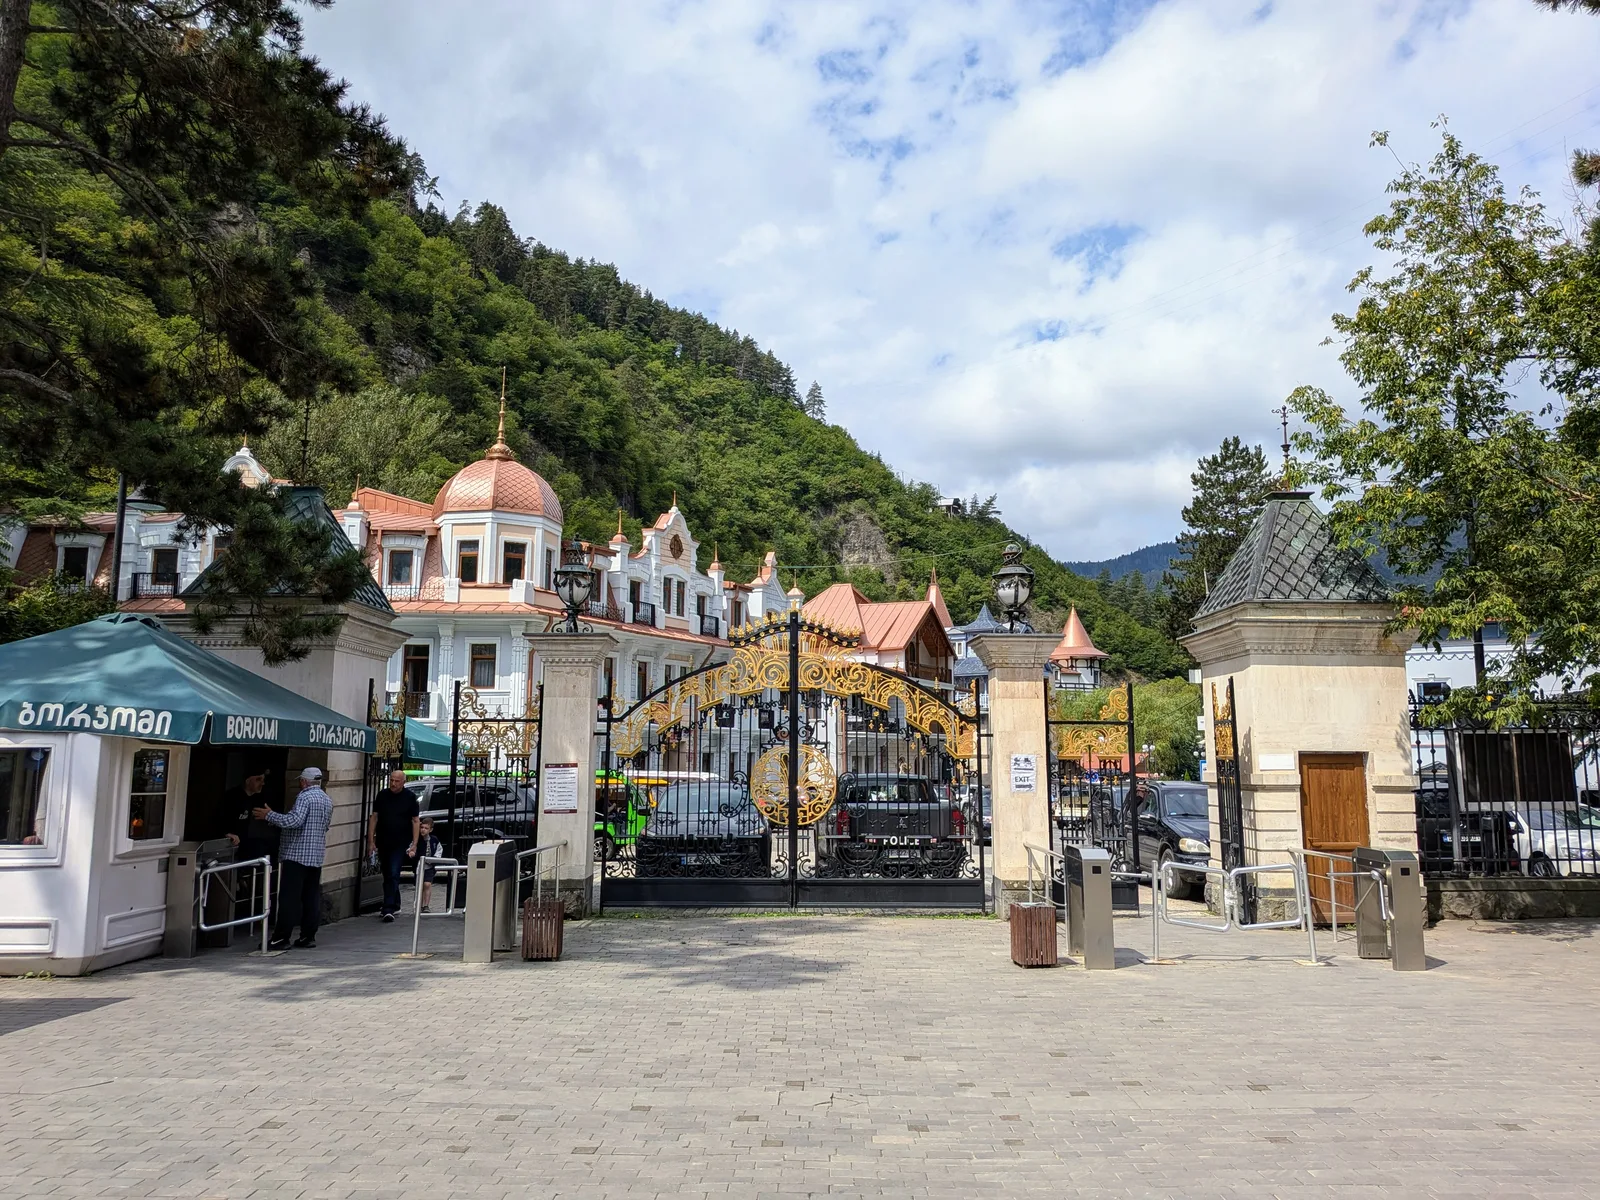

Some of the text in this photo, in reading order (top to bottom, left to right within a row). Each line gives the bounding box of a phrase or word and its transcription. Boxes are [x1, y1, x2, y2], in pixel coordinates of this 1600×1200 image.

[18, 701, 173, 736] ბორჯომი
[226, 715, 278, 741] BORJOMI
[309, 722, 366, 749] ბორჯომი
